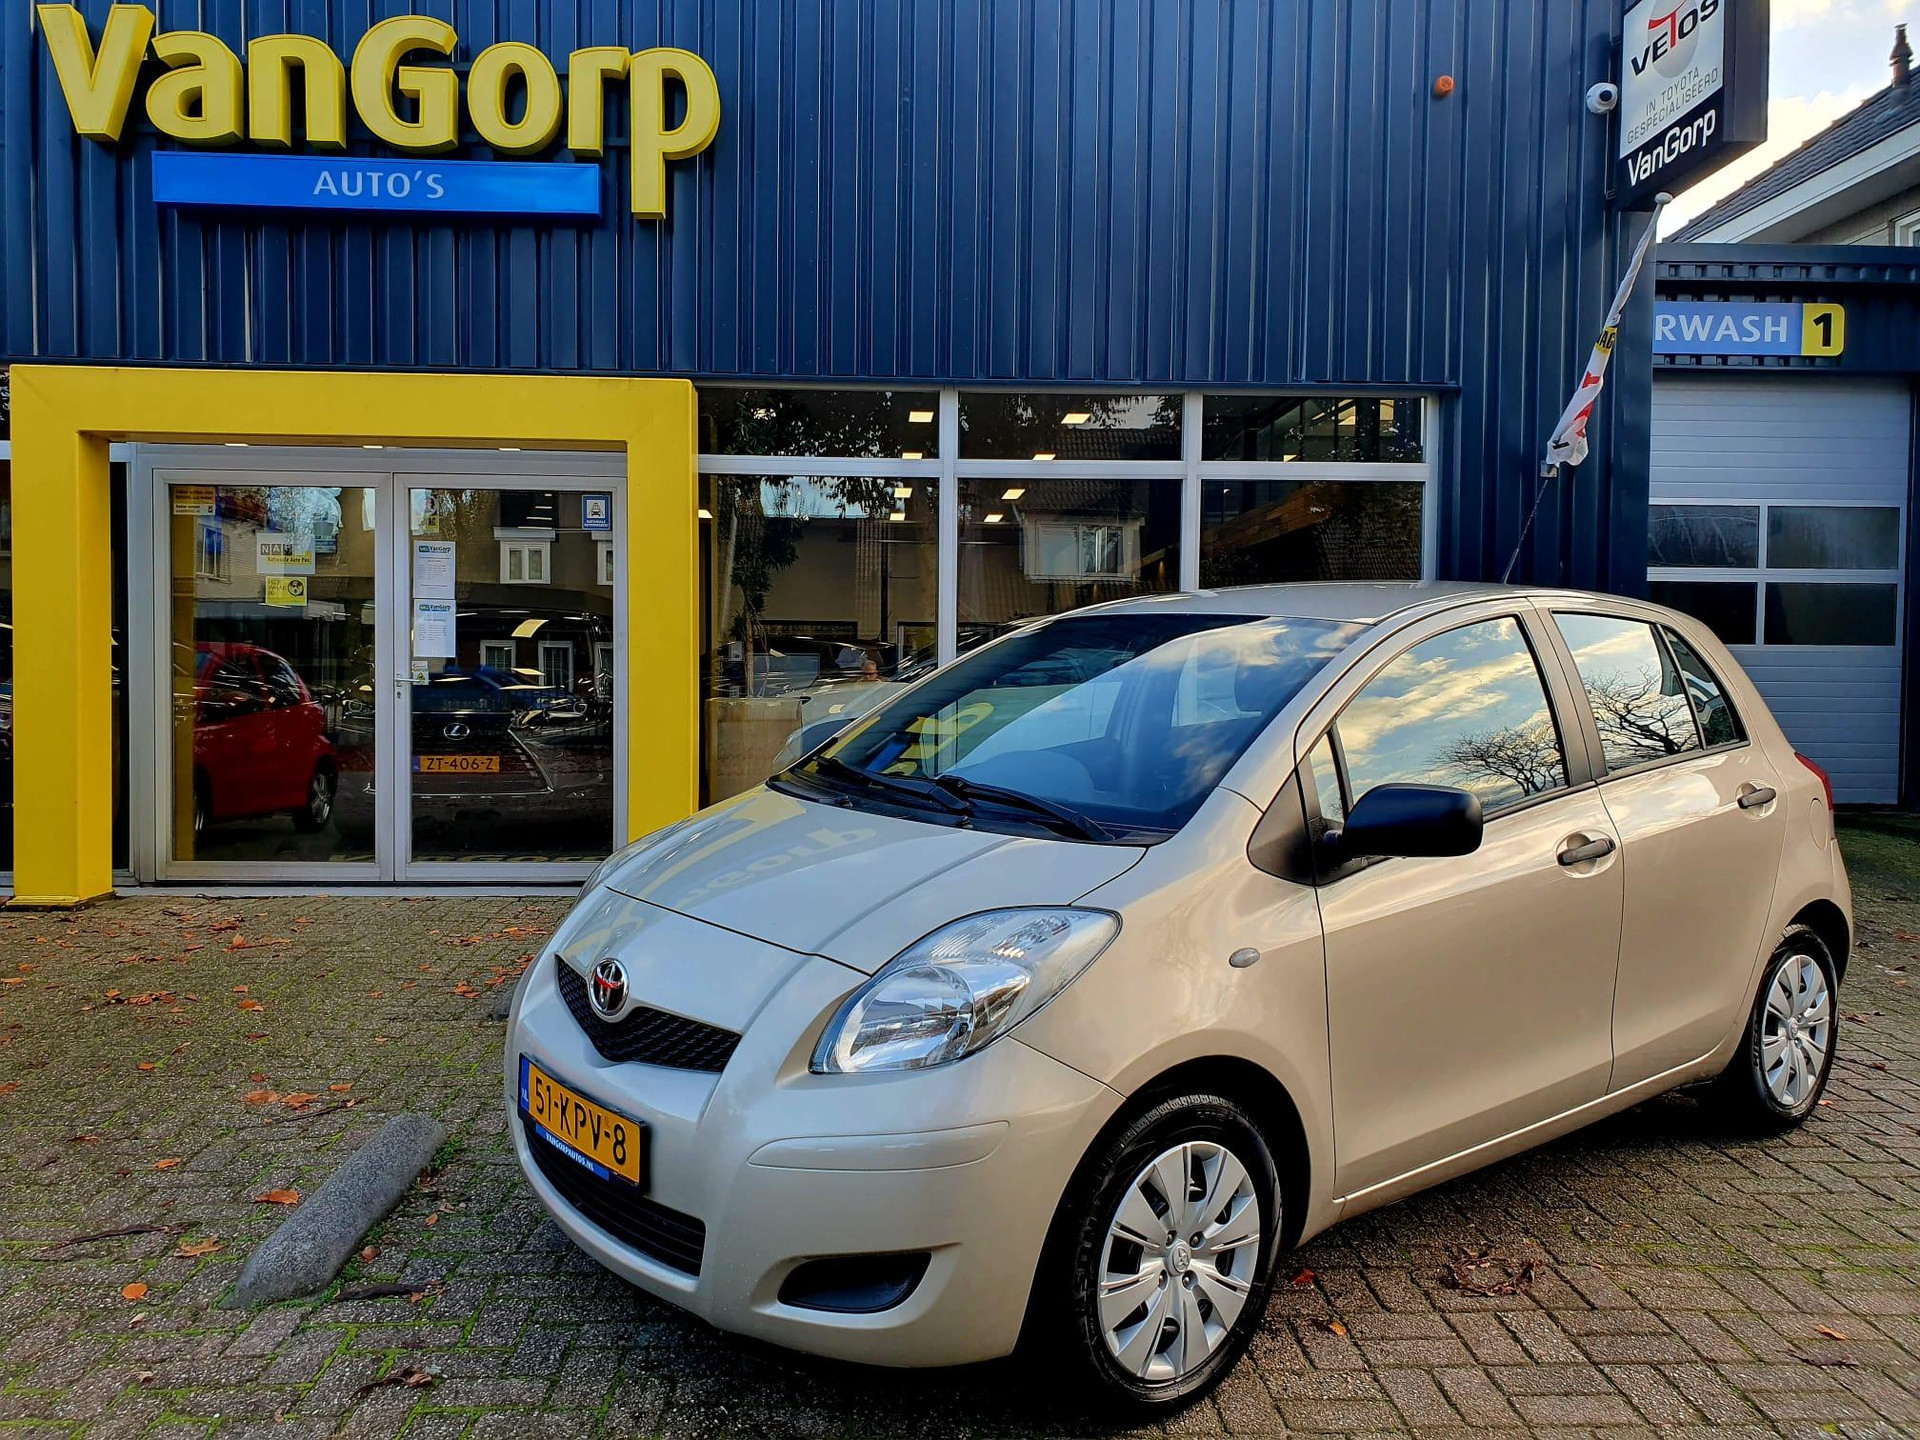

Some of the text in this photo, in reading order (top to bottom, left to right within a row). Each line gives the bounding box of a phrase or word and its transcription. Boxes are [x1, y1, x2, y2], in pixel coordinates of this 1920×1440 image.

[1631, 0, 1719, 77] VETOS
[37, 3, 722, 220] VanGorp
[1627, 68, 1718, 145] GESPECIALISEERD
[1646, 66, 1699, 117] IN TOYOTA
[1627, 109, 1716, 187] VanGorp
[312, 170, 445, 200] AUTO'S
[1597, 330, 1616, 350] AG
[1812, 312, 1832, 348] 1
[426, 757, 494, 771] ZT-406-Z
[535, 1075, 627, 1166] 51-KPV-8
